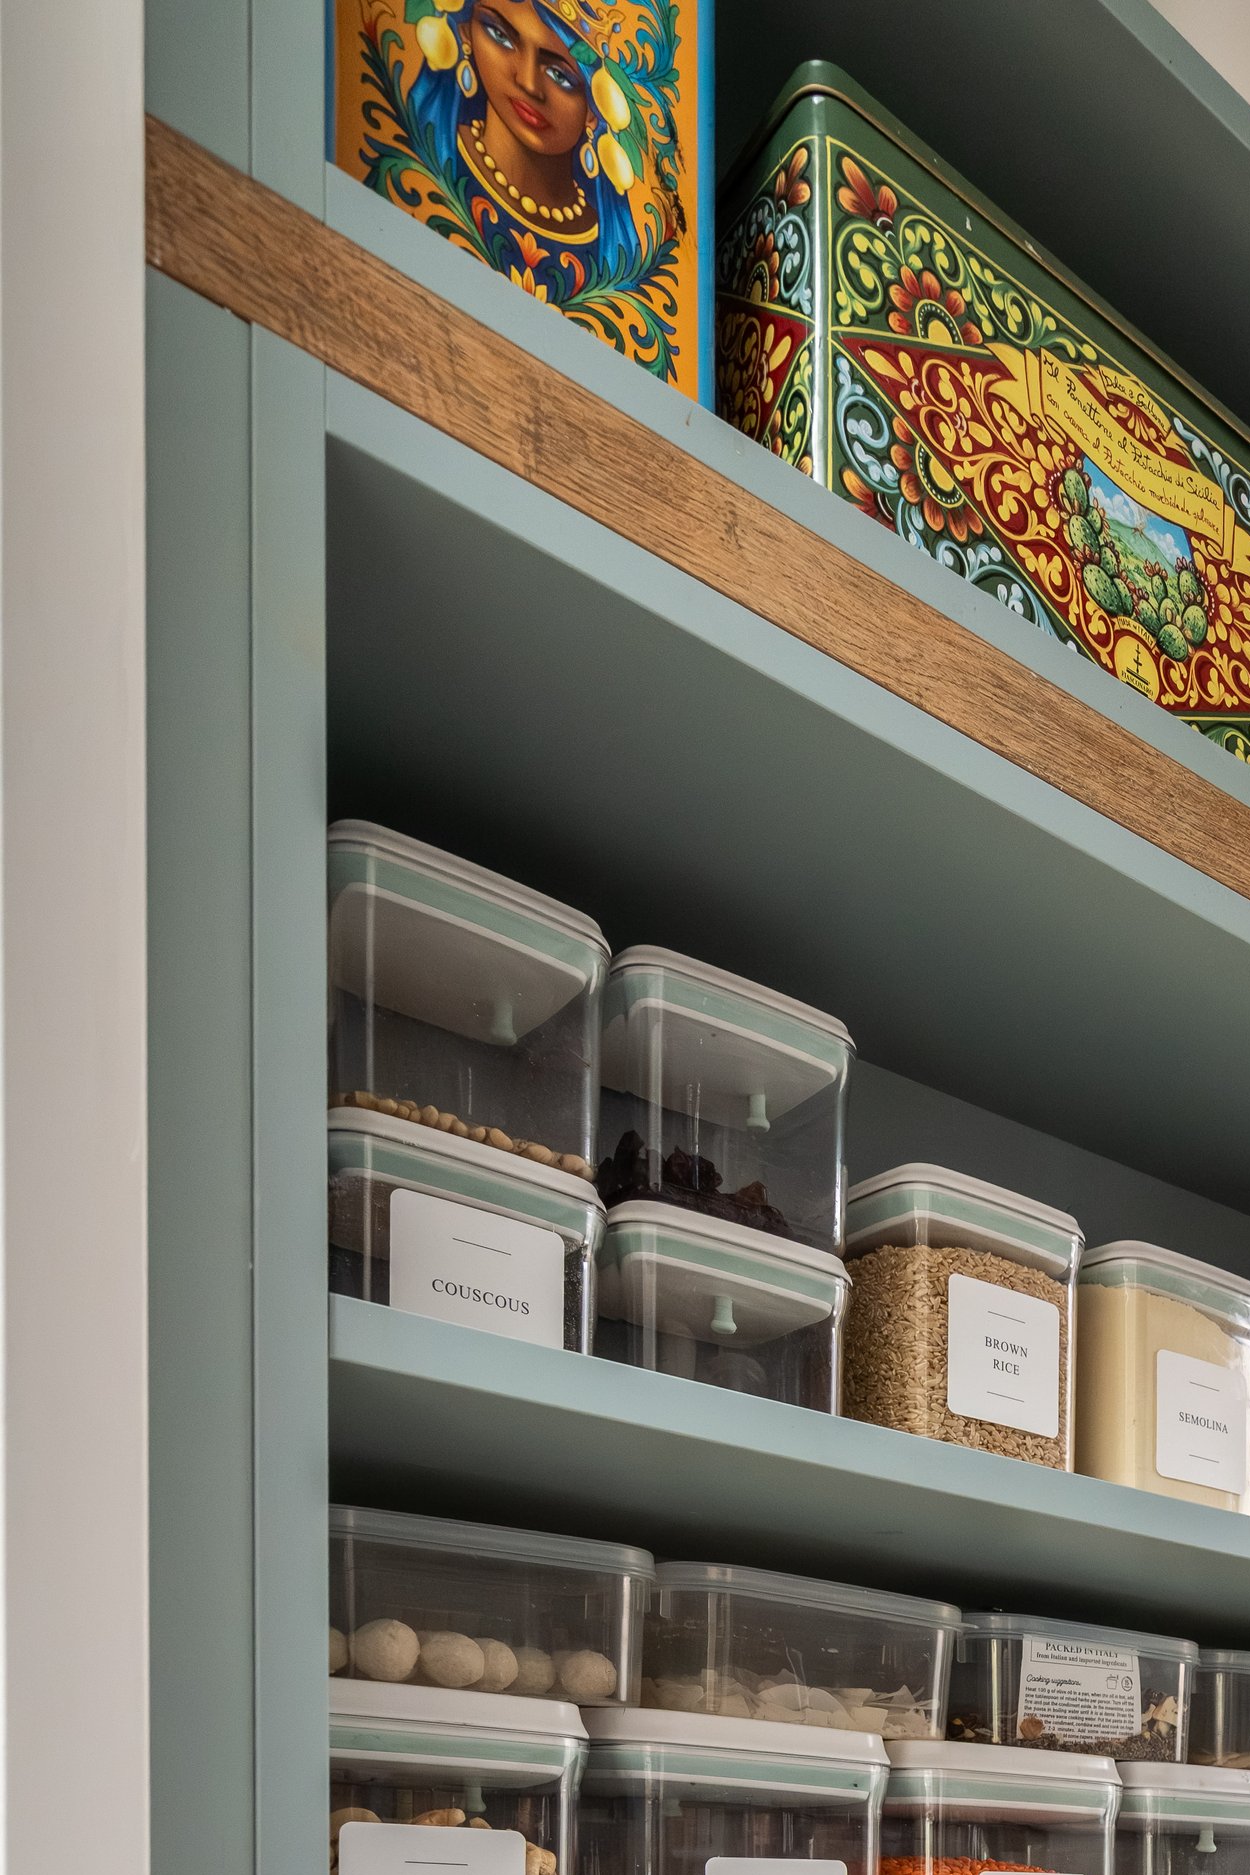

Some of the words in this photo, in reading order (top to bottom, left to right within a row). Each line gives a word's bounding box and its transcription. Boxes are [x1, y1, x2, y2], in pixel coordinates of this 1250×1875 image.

[1186, 476, 1220, 511] Sicilia
[432, 1278, 530, 1315] COUSCOUS
[984, 1335, 1028, 1358] BROWN
[993, 1359, 1020, 1375] RICE
[1178, 1411, 1229, 1434] SEMOLINA
[1045, 1642, 1082, 1654] PACKED
[1050, 1653, 1068, 1661] Italian
